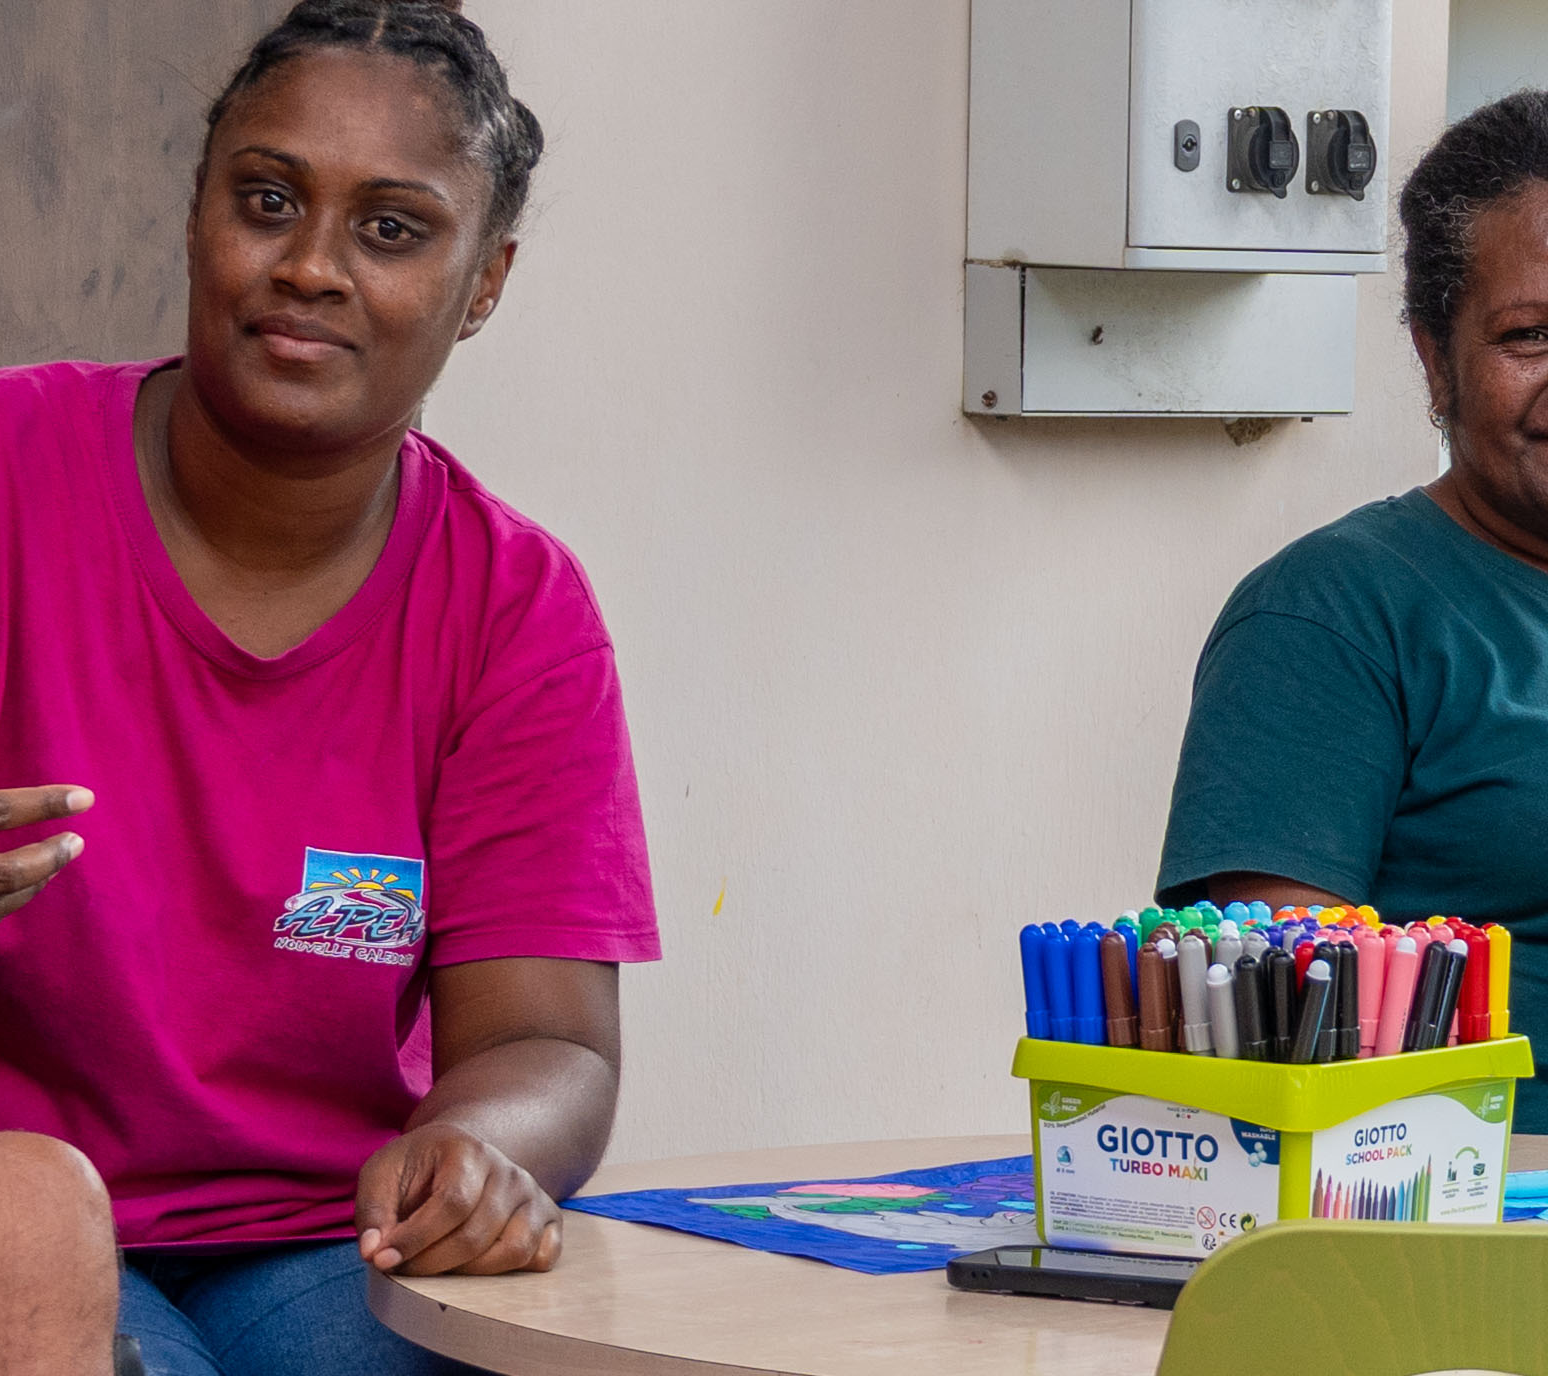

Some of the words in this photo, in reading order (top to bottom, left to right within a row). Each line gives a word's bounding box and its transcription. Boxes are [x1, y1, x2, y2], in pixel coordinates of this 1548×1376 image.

[274, 896, 425, 946] APEH
[275, 937, 352, 957] NOUVELLE
[1097, 1124, 1218, 1162] GIOTTO
[1354, 1123, 1407, 1147] GIOTTO
[1345, 1150, 1384, 1165] SCHOOL
[1387, 1144, 1412, 1158] PACK
[1109, 1158, 1163, 1177] TURBO
[1169, 1164, 1208, 1181] MAXI
